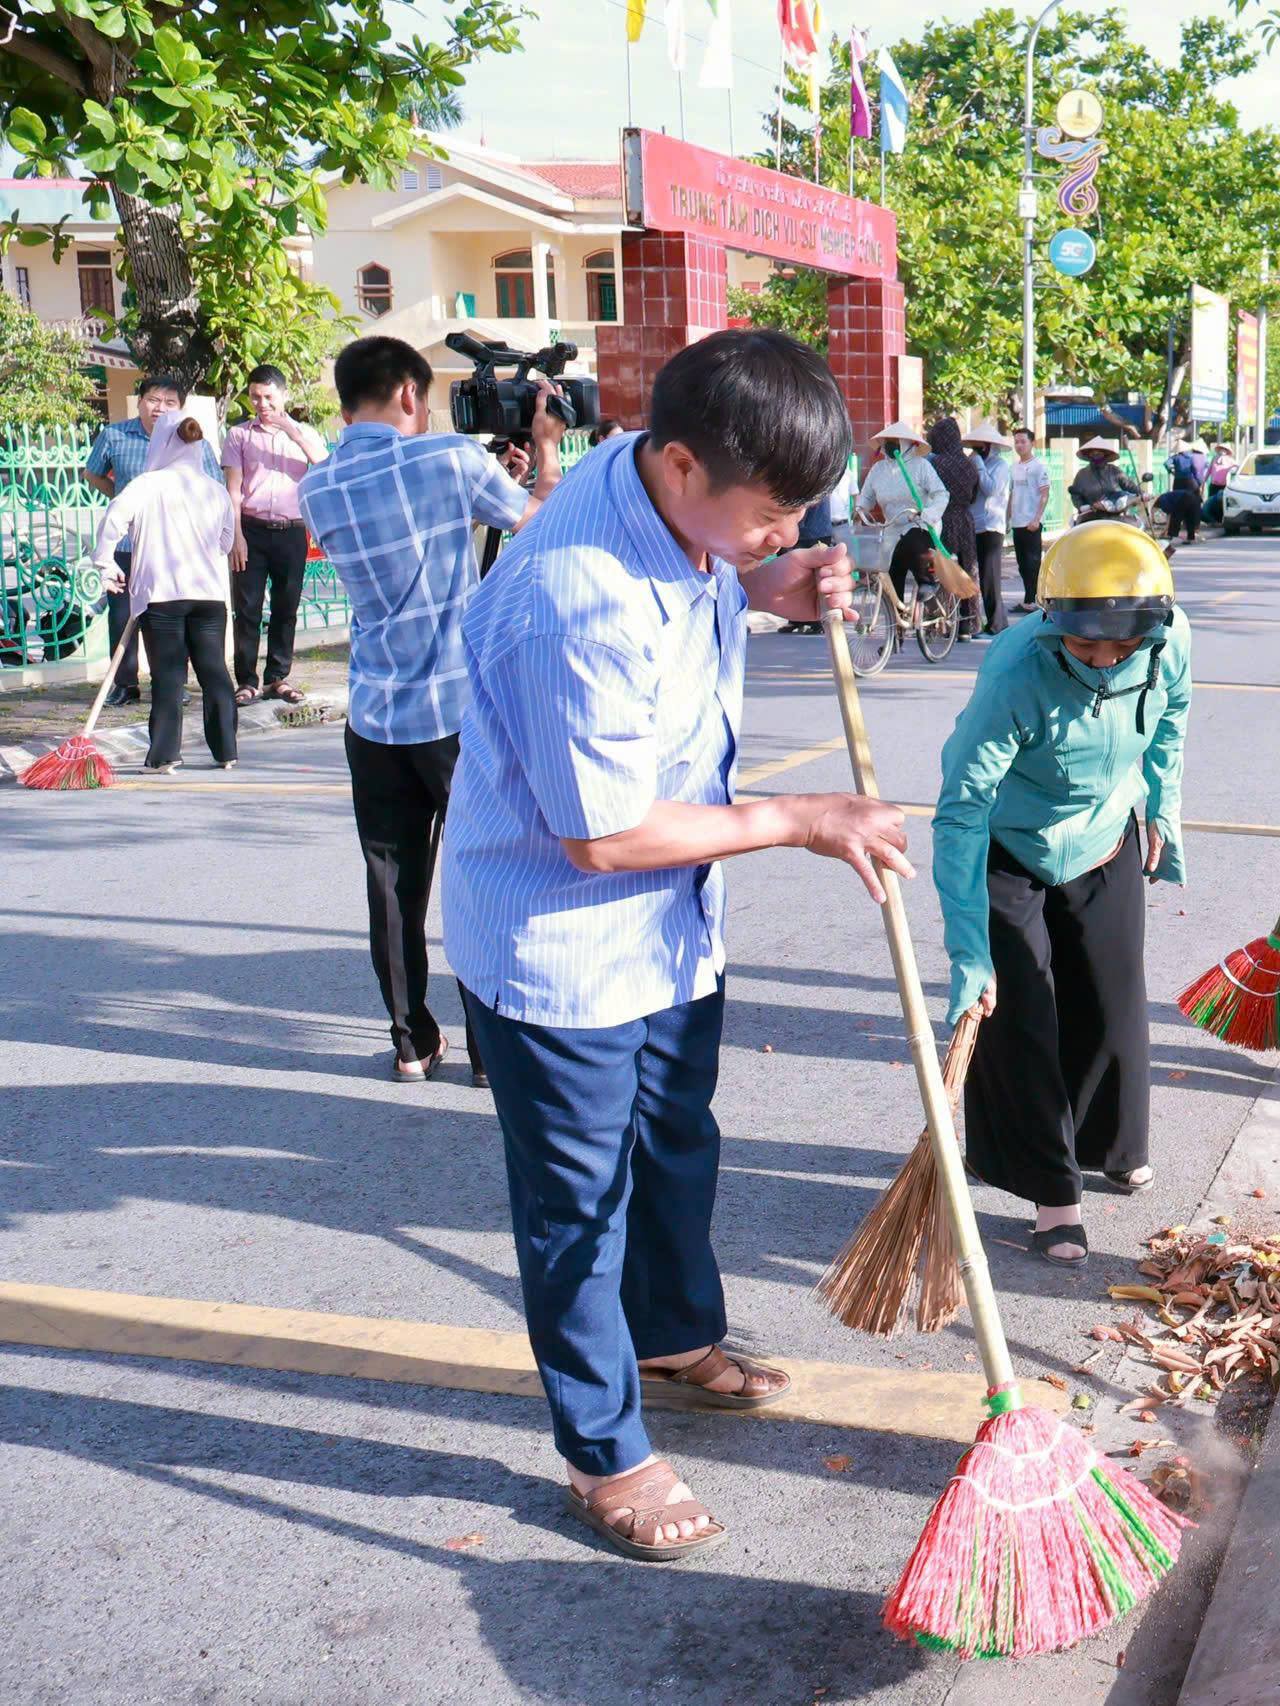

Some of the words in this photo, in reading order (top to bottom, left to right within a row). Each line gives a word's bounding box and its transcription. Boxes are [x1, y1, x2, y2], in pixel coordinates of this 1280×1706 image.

[670, 184, 716, 225] TRUNG
[721, 192, 748, 232] TÂM
[752, 207, 779, 243] DỊCH
